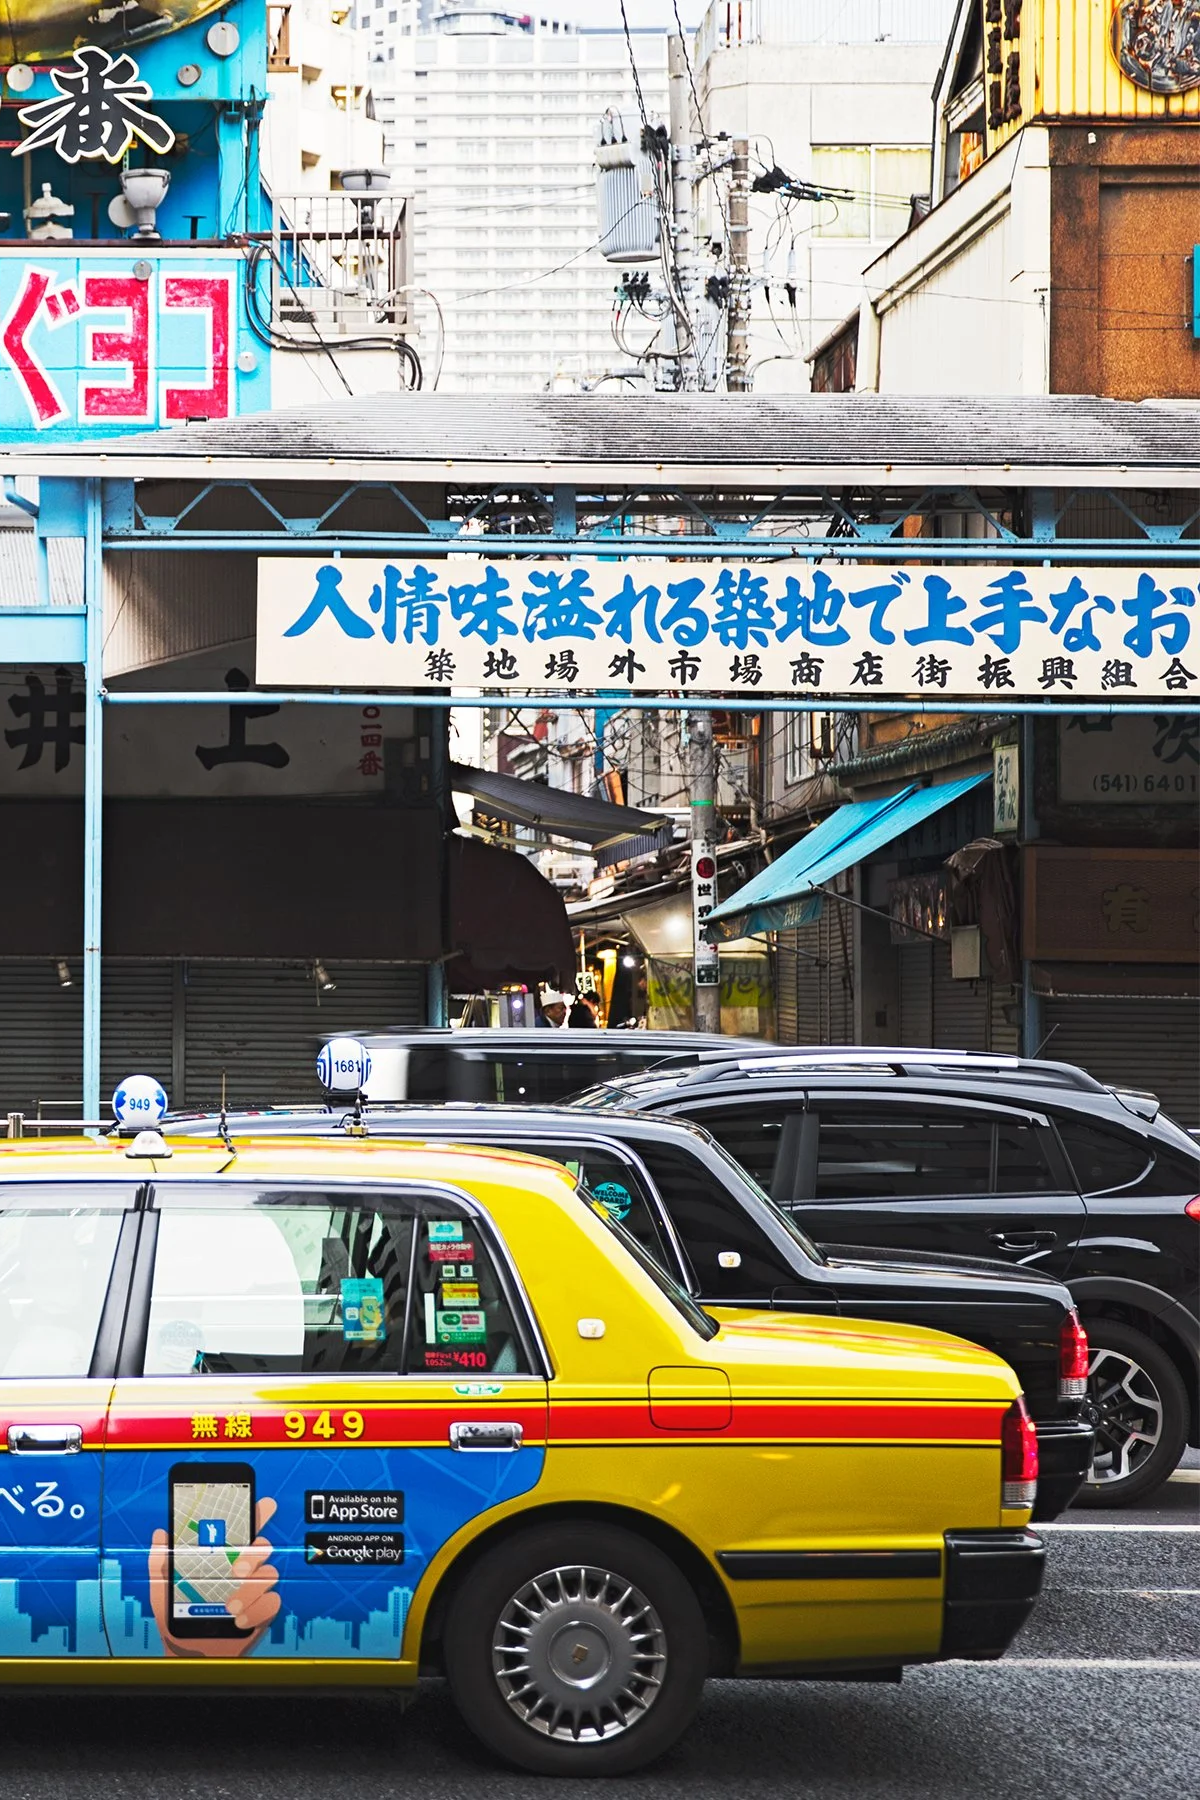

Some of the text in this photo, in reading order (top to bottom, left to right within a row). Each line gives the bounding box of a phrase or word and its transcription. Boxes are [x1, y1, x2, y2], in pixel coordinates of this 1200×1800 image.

[282, 563, 1200, 659] 人情味溢れる築地で上手なお
[334, 1060, 361, 1073] 1681
[129, 1098, 151, 1111] 949
[191, 1410, 366, 1440] 無線 949
[328, 1495, 368, 1503] Available
[383, 1495, 398, 1503] the
[328, 1504, 398, 1520] App Store
[326, 1545, 402, 1562] Google play
